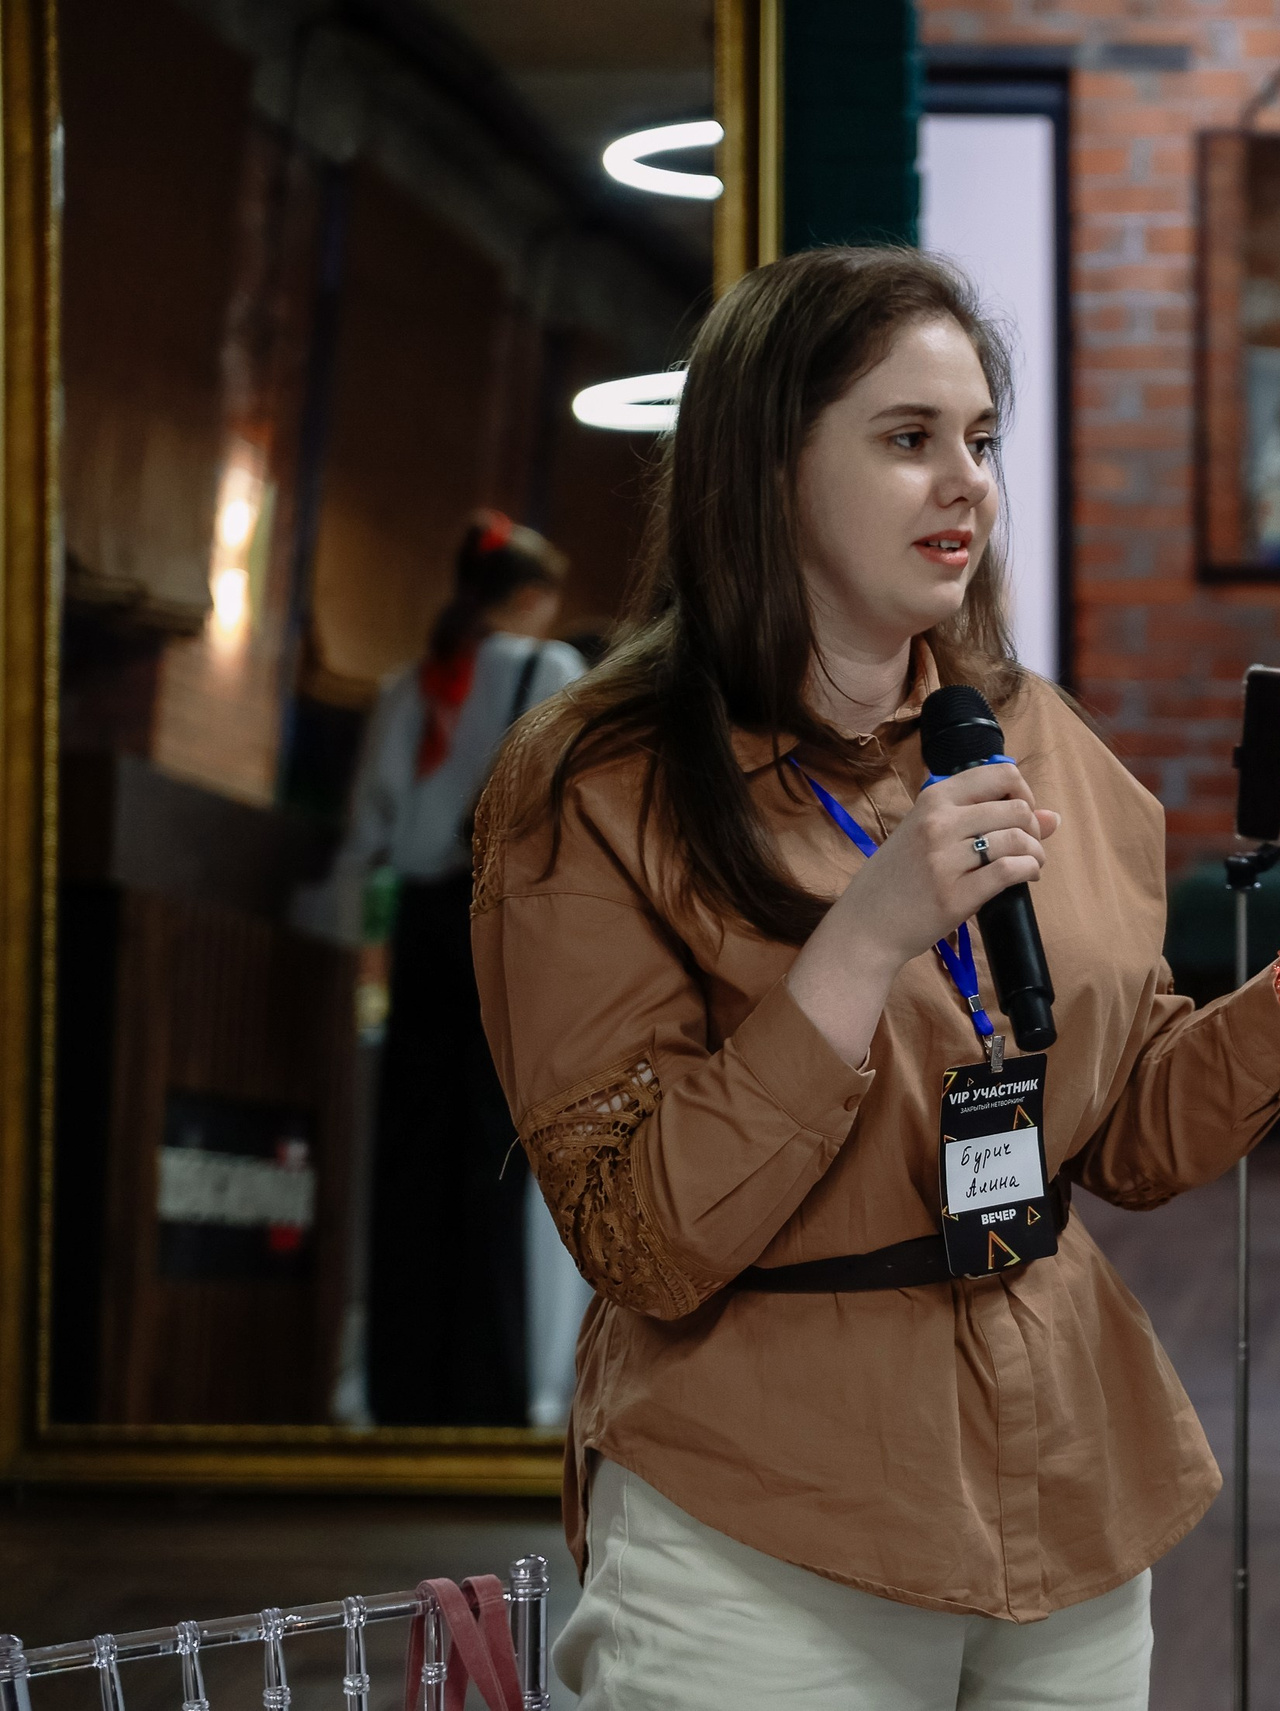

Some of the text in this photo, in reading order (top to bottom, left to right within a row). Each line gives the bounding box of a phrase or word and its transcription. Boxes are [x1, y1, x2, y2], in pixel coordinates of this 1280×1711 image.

[949, 1079, 1038, 1105] VIP УЧАСТНИК
[960, 1096, 1026, 1114] ЗАКРЫТЫЙ НЕТВОРКИНГ
[960, 1143, 1012, 1174] Бурич
[965, 1174, 1020, 1198] Алина
[981, 1208, 1017, 1225] ВЕЧЕР
